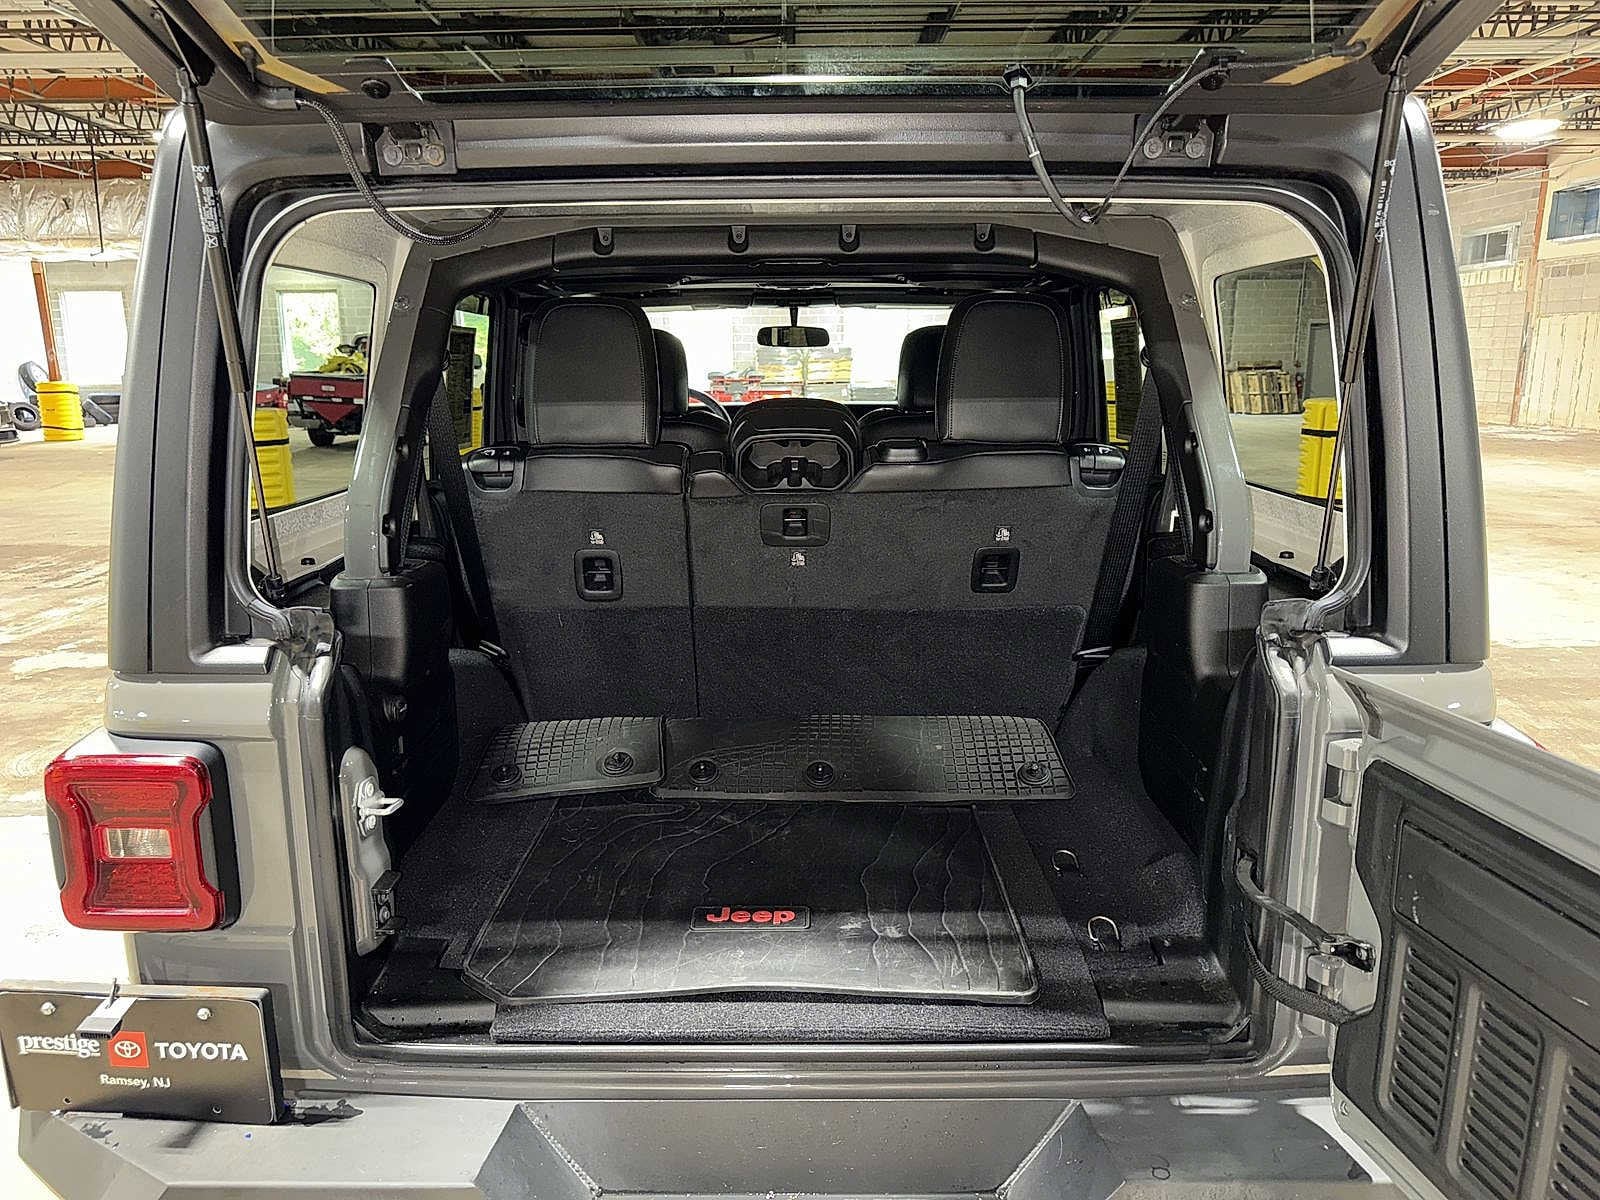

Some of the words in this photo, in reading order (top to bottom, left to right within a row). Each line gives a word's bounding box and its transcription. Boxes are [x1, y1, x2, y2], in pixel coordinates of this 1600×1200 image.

[1374, 180, 1387, 228] STABILUS
[706, 906, 796, 926] Jeep
[17, 1033, 101, 1058] prestige
[154, 1042, 248, 1061] TOYOTA
[100, 1074, 150, 1089] Ramsey,
[153, 1076, 171, 1088] NJ
